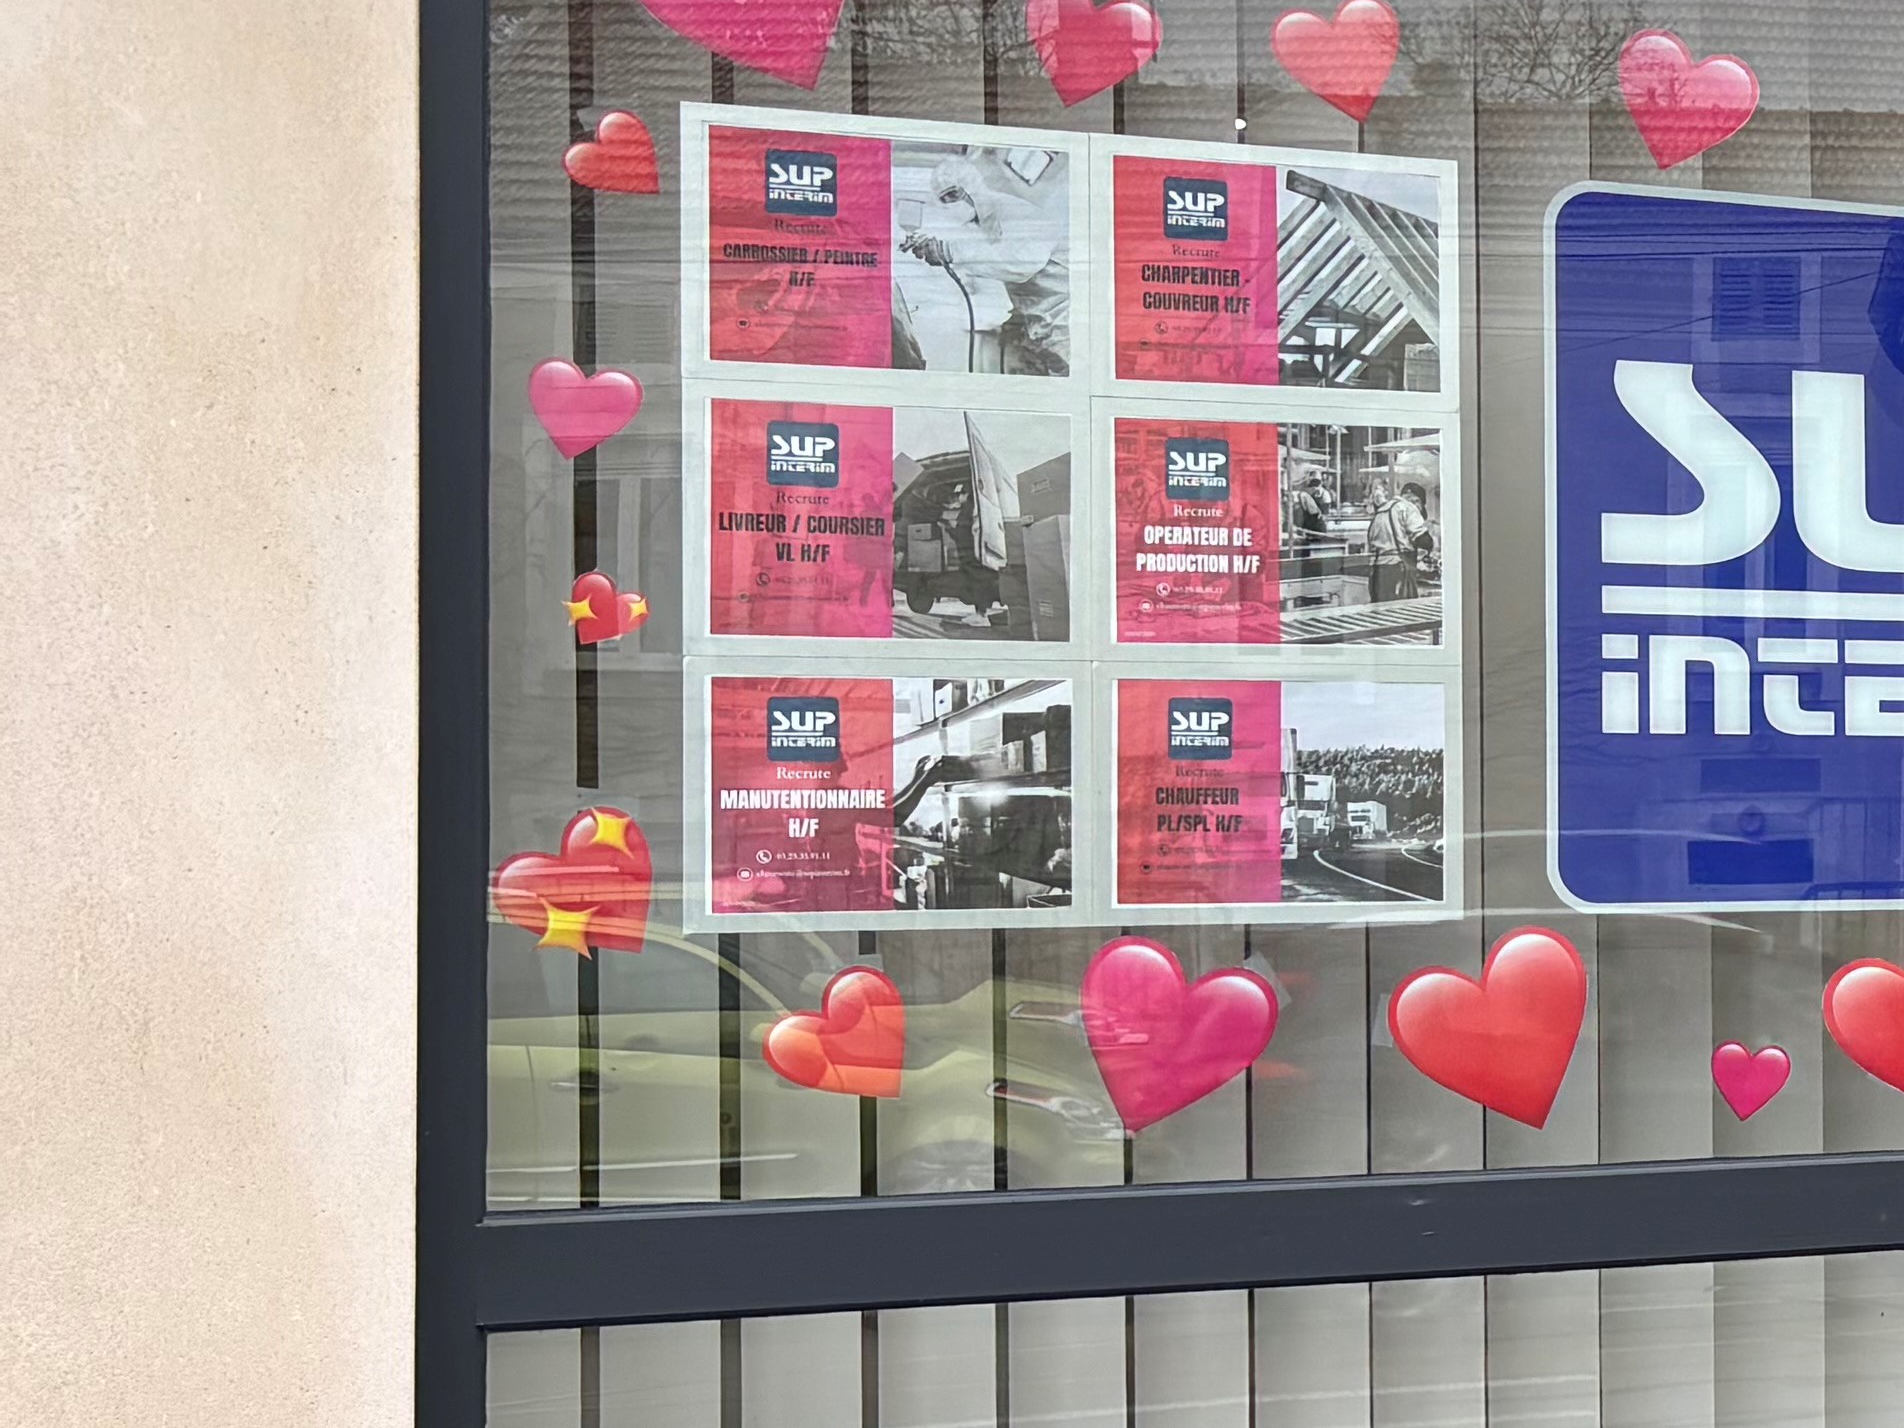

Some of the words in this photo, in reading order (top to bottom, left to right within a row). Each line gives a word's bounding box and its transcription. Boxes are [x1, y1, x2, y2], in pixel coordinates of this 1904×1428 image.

[769, 164, 833, 186] SUP
[1167, 191, 1225, 212] SUP
[723, 243, 808, 263] CARROSSIER
[813, 249, 820, 263] /
[824, 250, 878, 267] PEINTRE
[1142, 264, 1240, 287] CHARPENTIER
[1143, 292, 1219, 312] COUVREUR
[1224, 295, 1250, 314] H/F
[771, 435, 835, 456] SUP
[1169, 451, 1226, 472] SUP
[776, 491, 829, 505] Recrute
[1174, 504, 1224, 517] Recrute
[719, 512, 786, 533] LIVREUR
[792, 515, 800, 533] /
[807, 515, 885, 536] COURSIER
[1144, 525, 1228, 546] OPERATEUR
[1233, 528, 1252, 546] DE
[776, 543, 795, 562] VL
[801, 543, 830, 562] H/F
[1136, 553, 1228, 572] PRODUCTION
[1234, 555, 1260, 574] H/F
[771, 711, 836, 731] SUP
[1171, 711, 1229, 731] SUP
[777, 767, 831, 780] Recrute
[720, 789, 885, 809] MANUTENTIONNAIRE
[1156, 787, 1239, 805] CHAUFFEUR
[789, 818, 819, 838] H/F
[1157, 814, 1210, 832] PL/SPL
[1216, 815, 1243, 832] H/F
